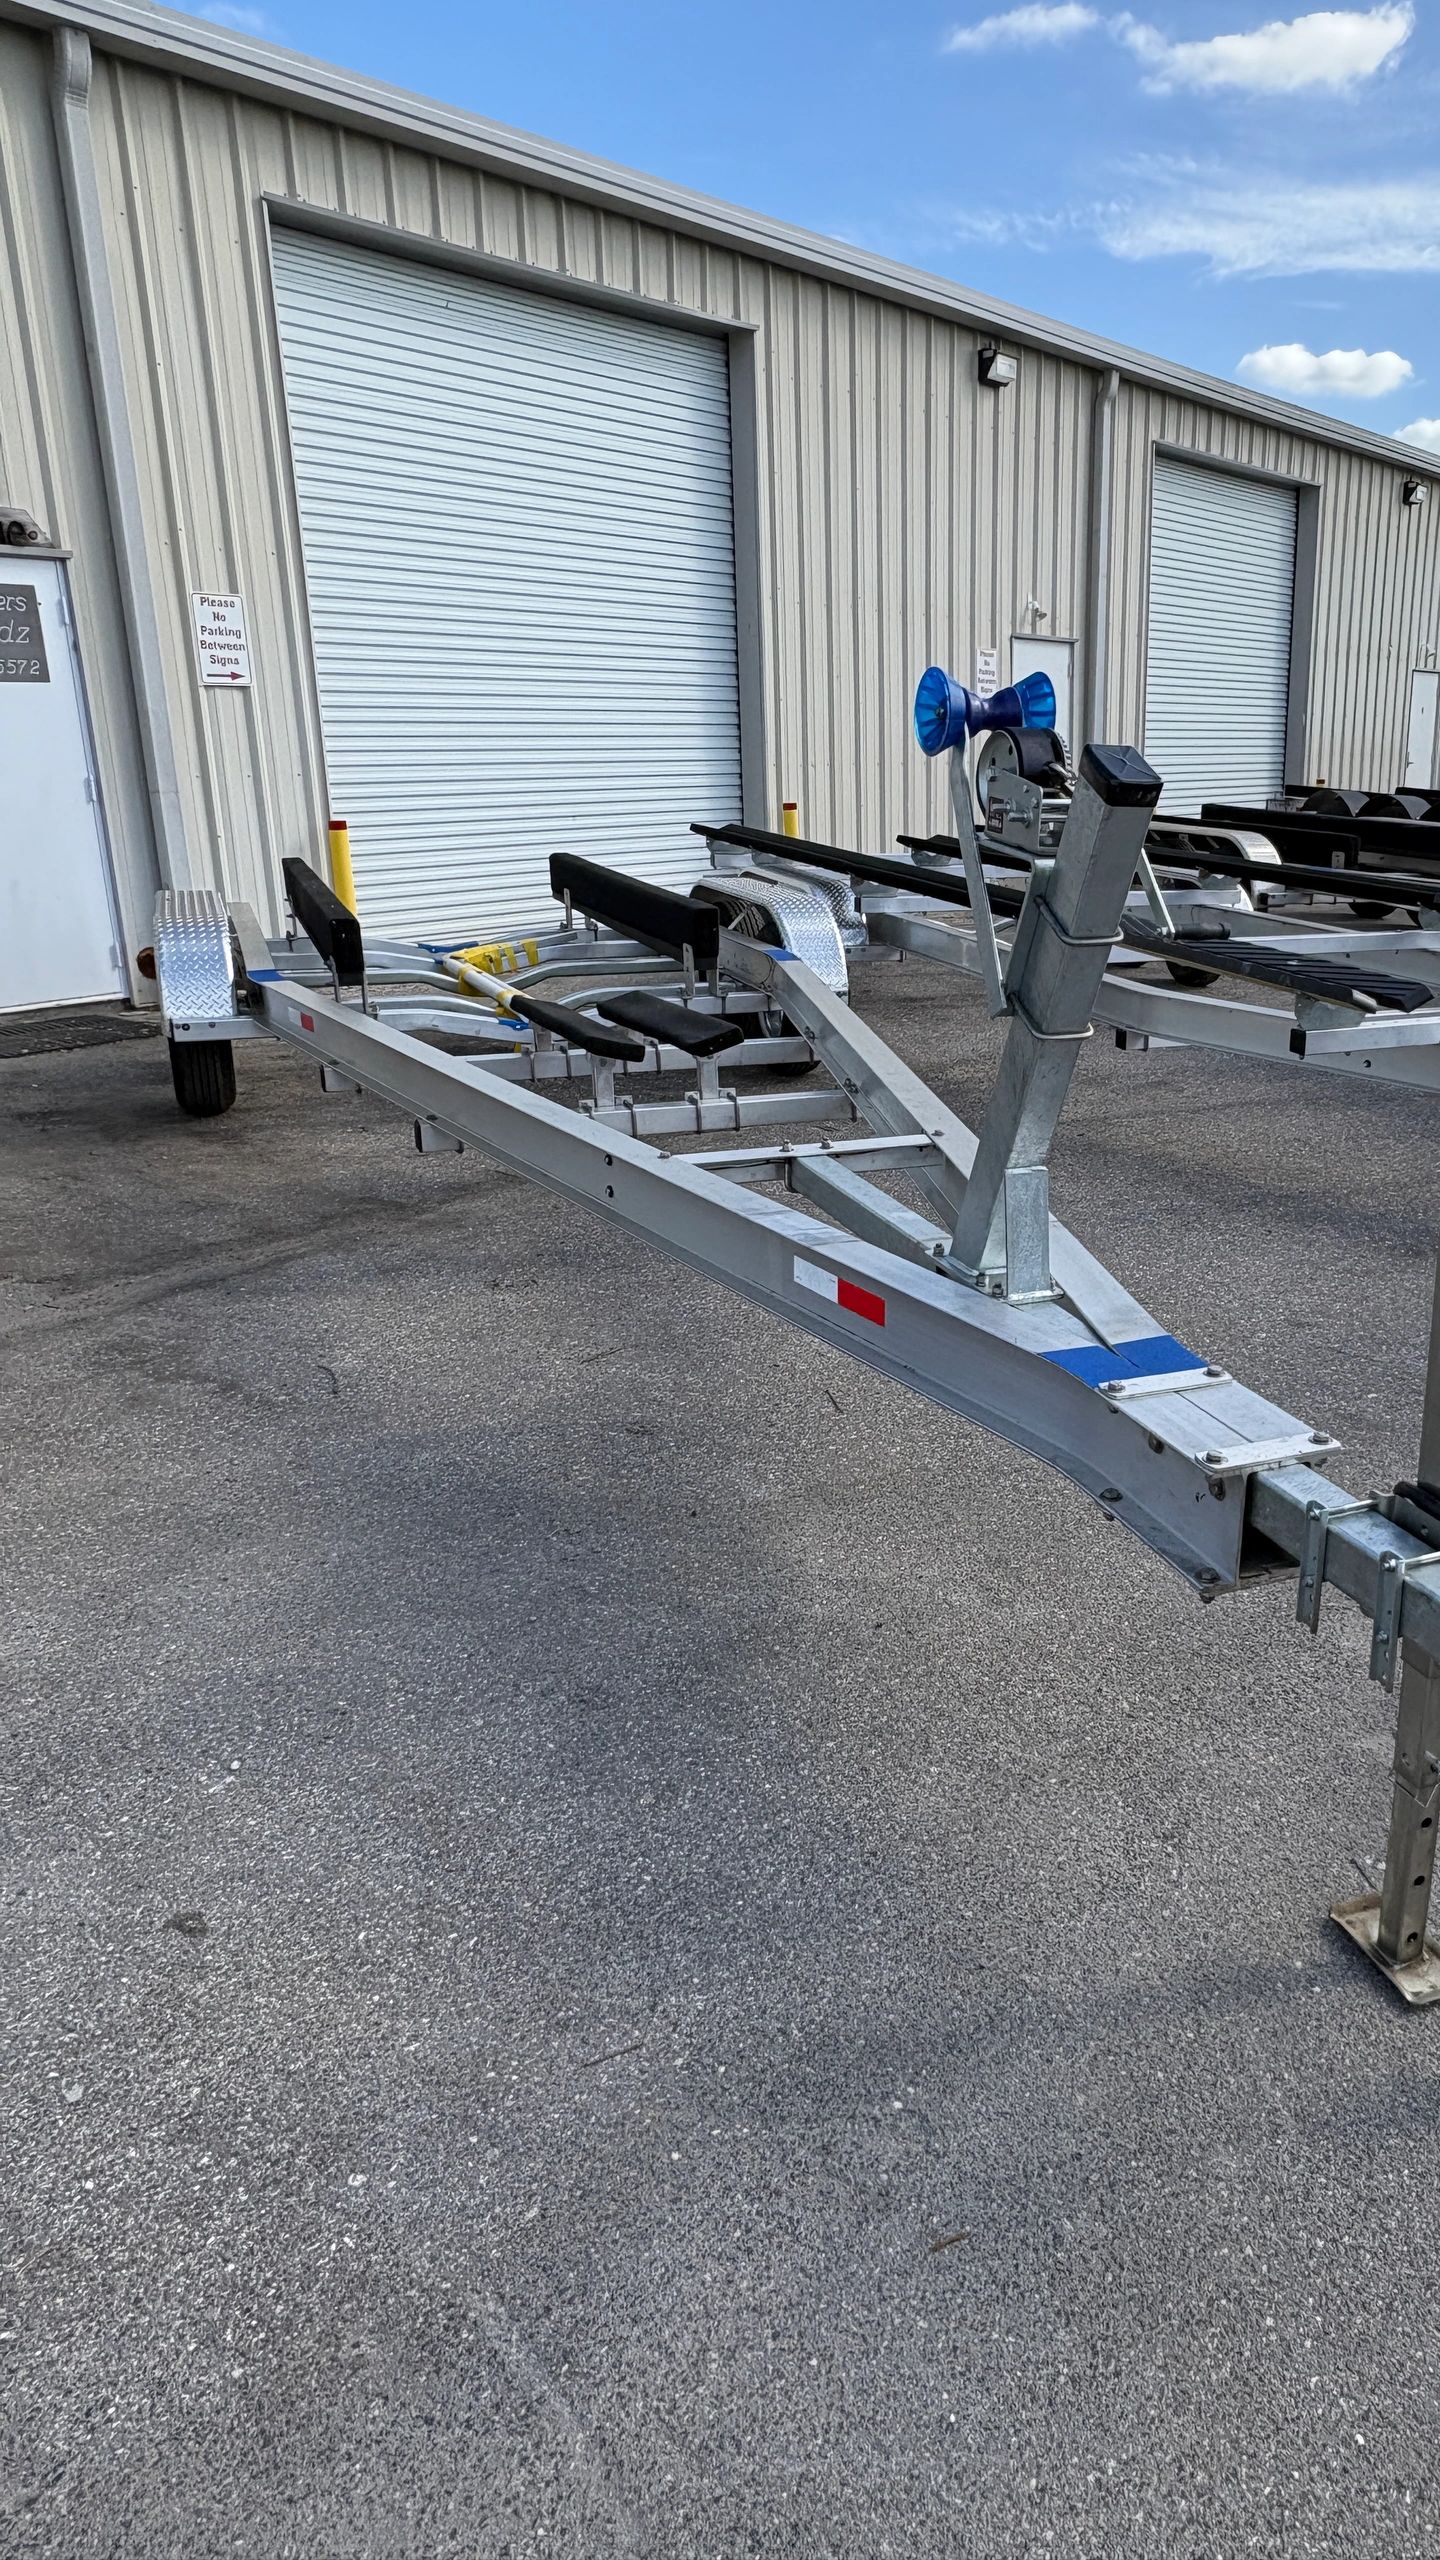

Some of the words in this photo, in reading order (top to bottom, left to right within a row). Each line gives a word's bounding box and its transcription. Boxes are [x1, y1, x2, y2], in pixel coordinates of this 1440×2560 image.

[200, 596, 236, 608] Please
[212, 611, 226, 622] No
[200, 625, 242, 639] Parking
[200, 639, 246, 651] Between
[209, 654, 240, 667] Signs
